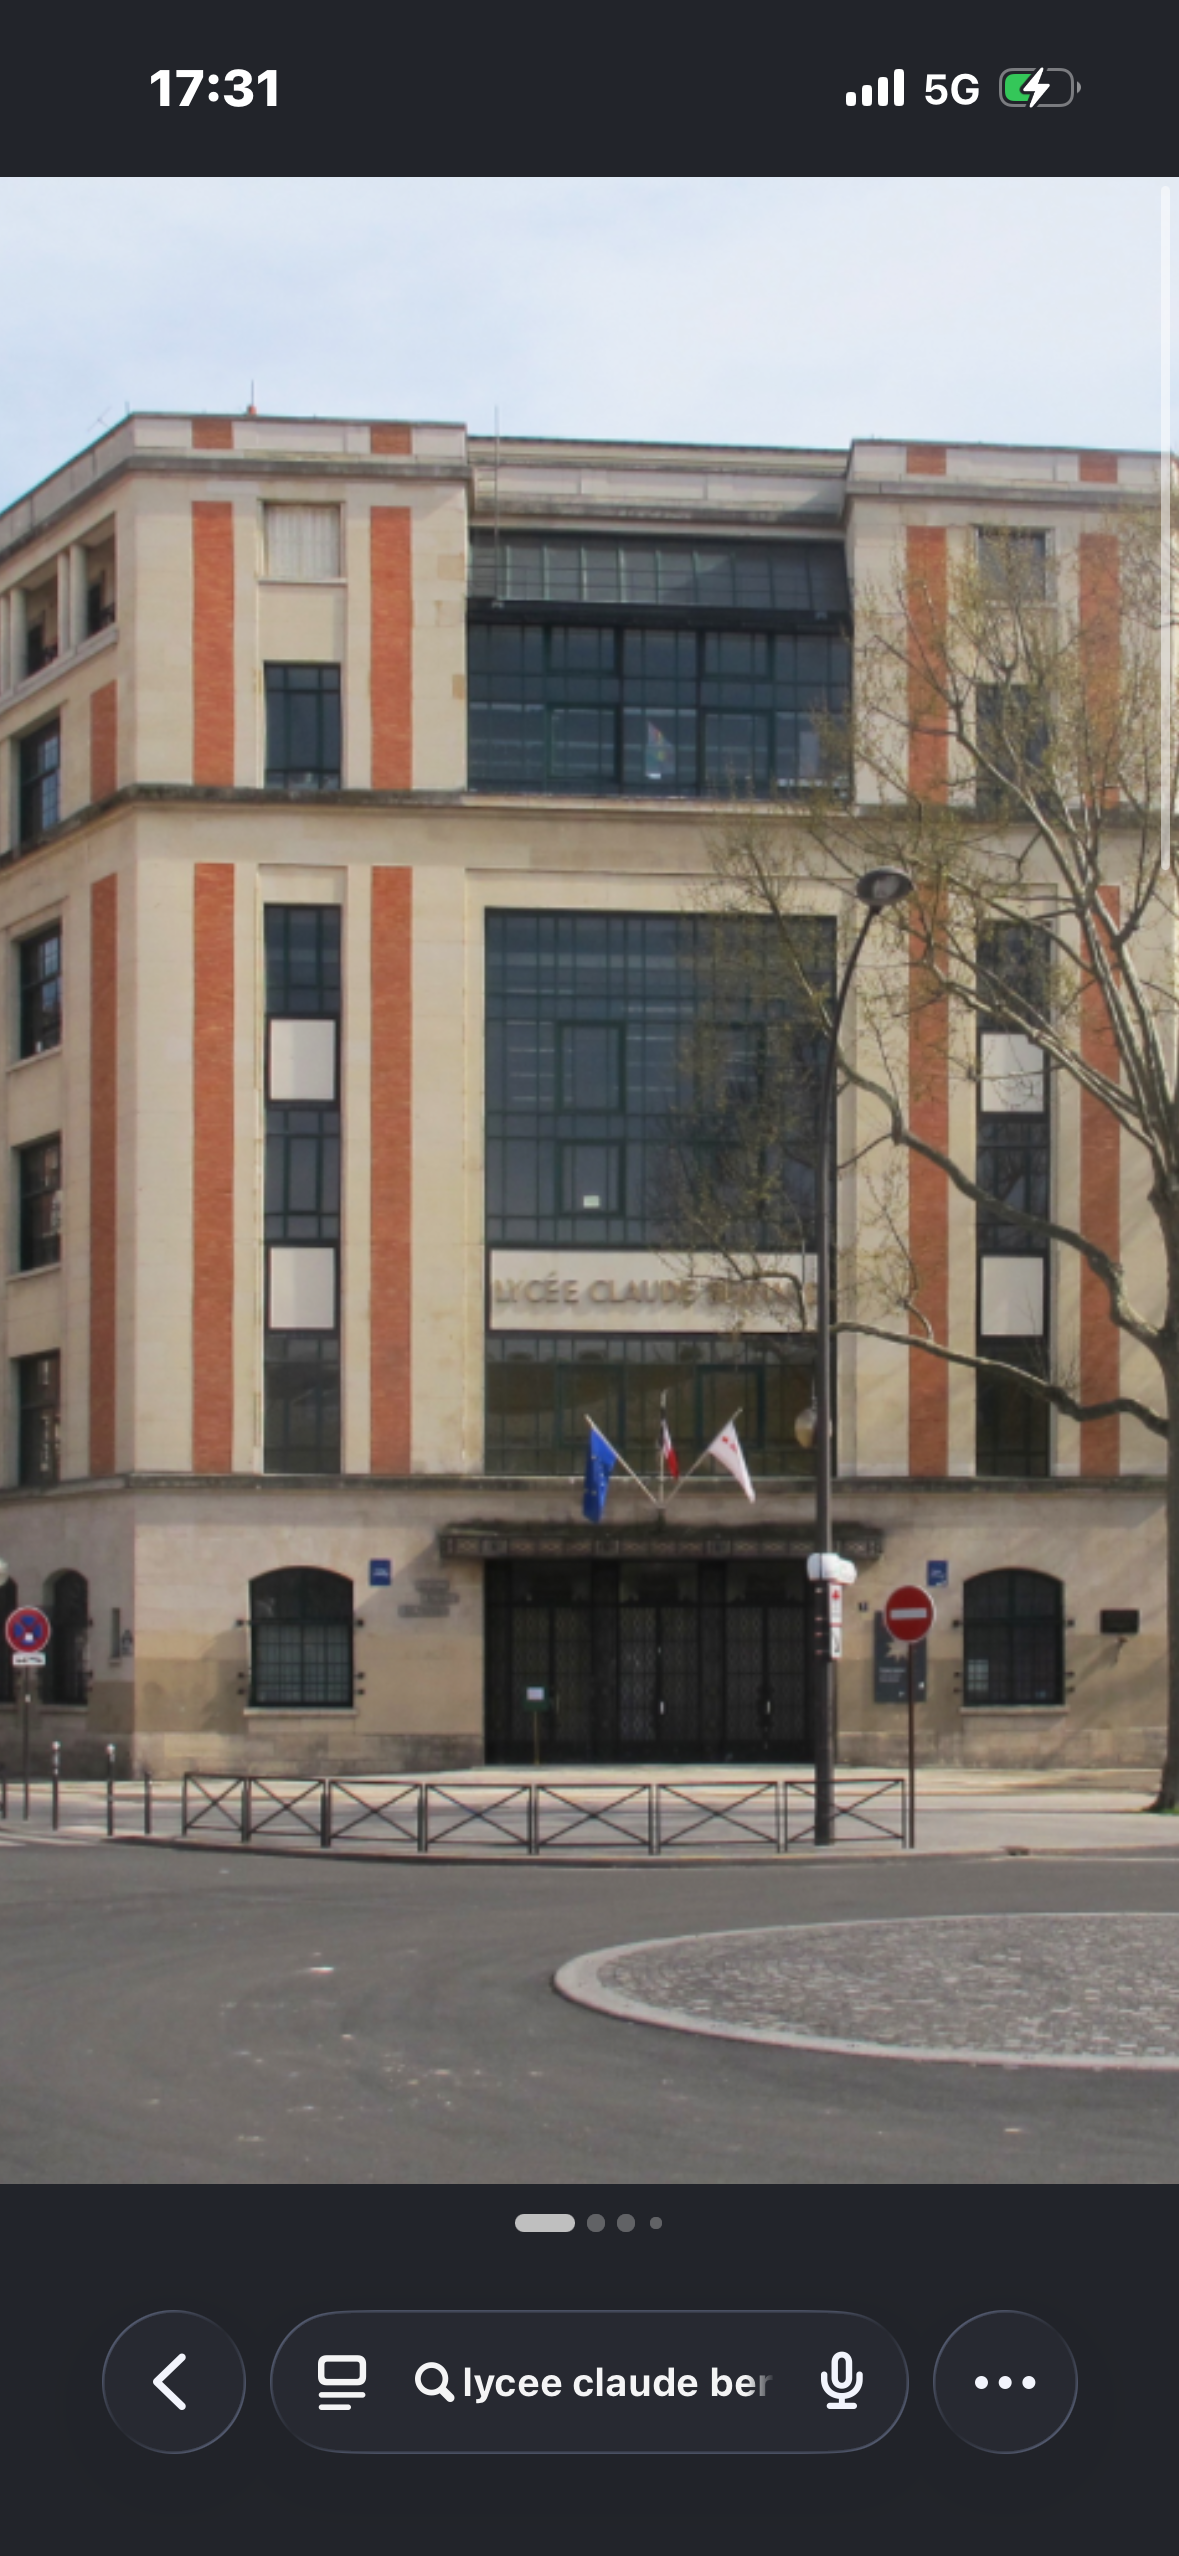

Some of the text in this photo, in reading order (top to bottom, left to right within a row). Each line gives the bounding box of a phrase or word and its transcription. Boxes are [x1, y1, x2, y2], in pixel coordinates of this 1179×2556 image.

[150, 69, 278, 107] 17:31
[924, 72, 980, 106] 5G
[494, 1271, 579, 1304] LYCÉE
[588, 1279, 697, 1305] CLAUDE
[464, 2366, 773, 2405] lycee claude ber
